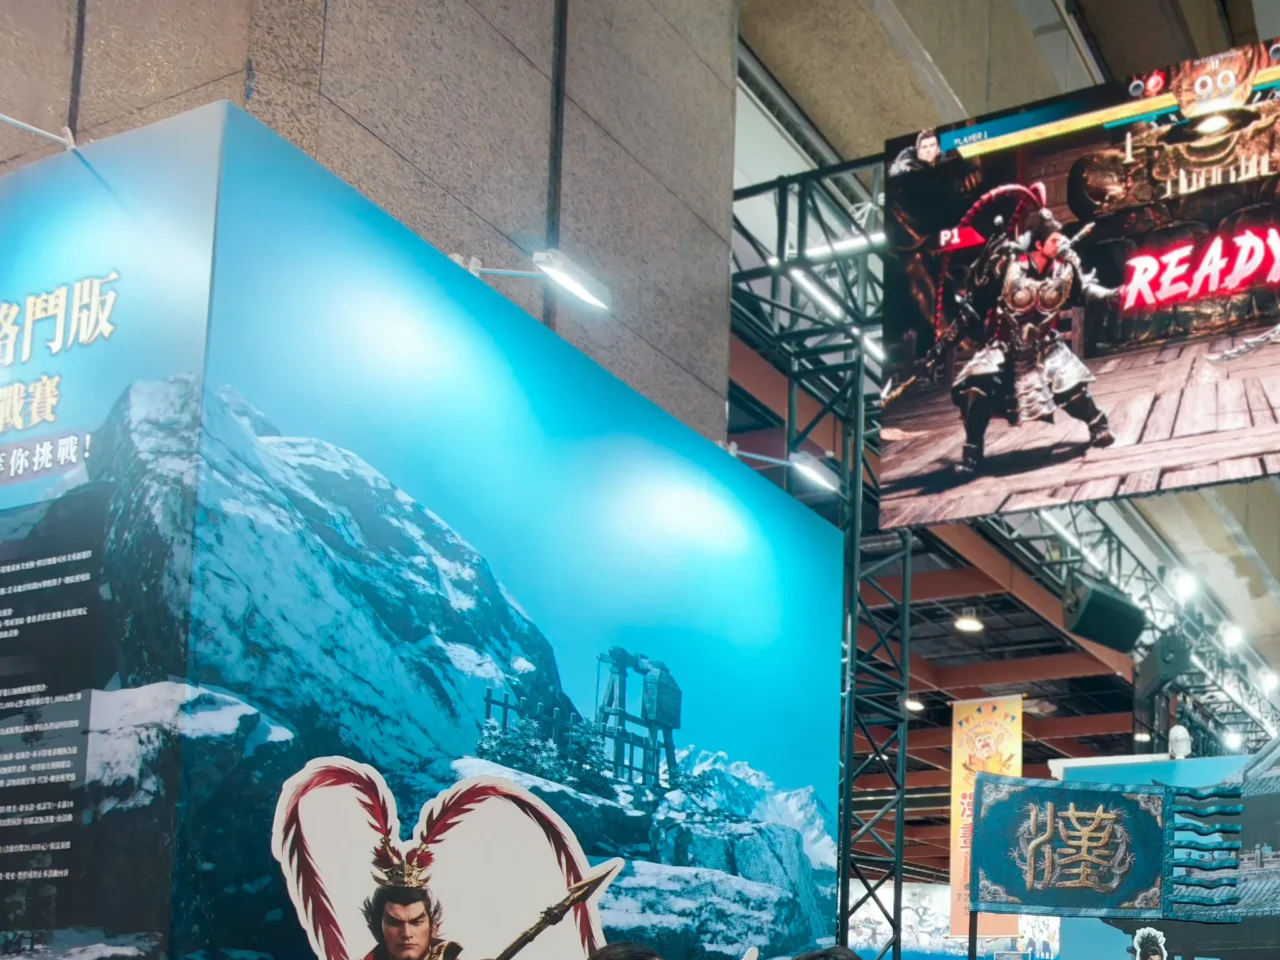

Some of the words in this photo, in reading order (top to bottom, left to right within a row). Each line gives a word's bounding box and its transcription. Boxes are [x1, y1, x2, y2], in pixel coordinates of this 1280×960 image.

[1194, 70, 1236, 102] 99
[954, 131, 984, 145] PLAYER
[940, 228, 961, 246] P1
